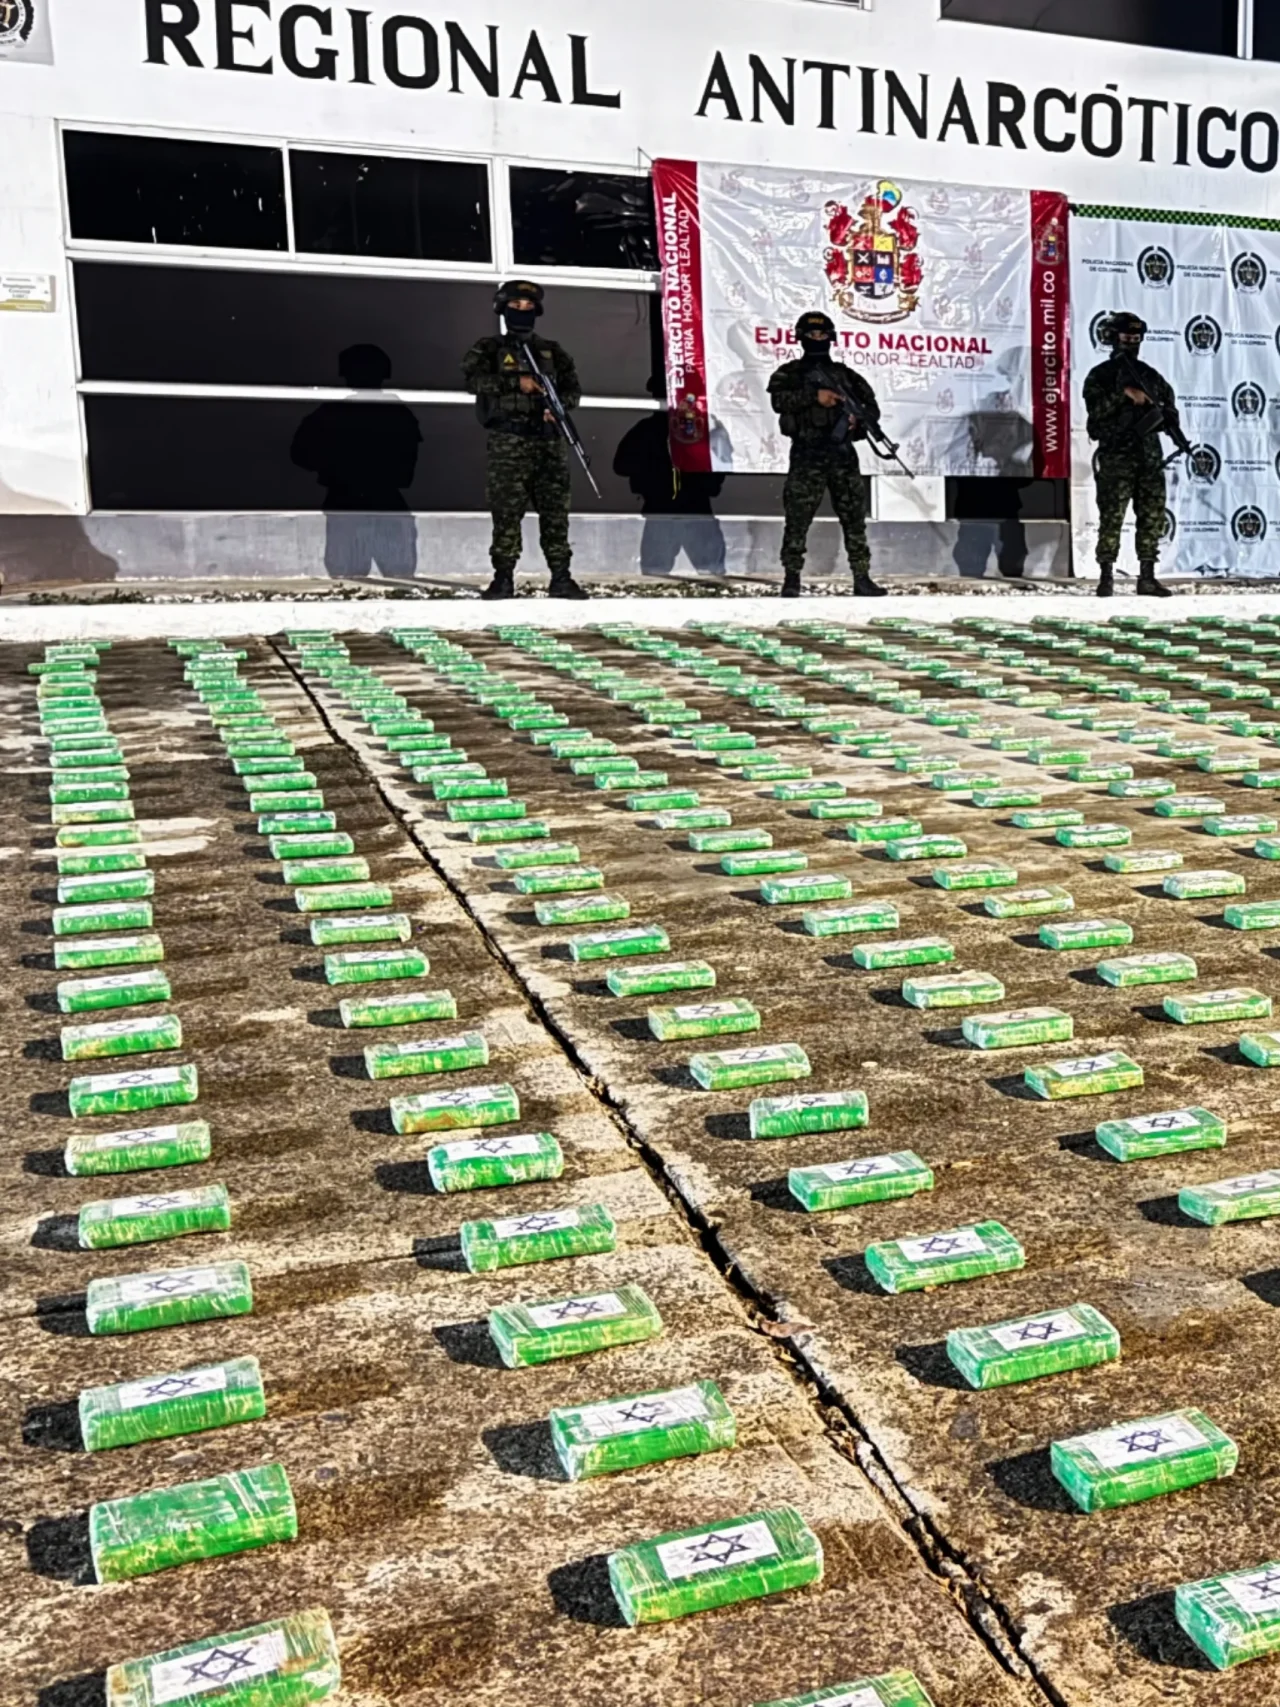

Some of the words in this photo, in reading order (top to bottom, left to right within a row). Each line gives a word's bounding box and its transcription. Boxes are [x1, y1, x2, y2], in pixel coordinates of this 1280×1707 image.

[142, 0, 621, 108] REGIONAL
[662, 191, 682, 293] NACIONAL
[677, 208, 690, 267] LEALTAD
[680, 273, 693, 322] HONOR
[684, 328, 695, 373] PATRIA
[755, 324, 870, 349] EJÉTO
[878, 333, 993, 354] NACIONAL
[909, 352, 975, 369] LEALTAD
[1040, 270, 1060, 452] www.ejercito.mil.co
